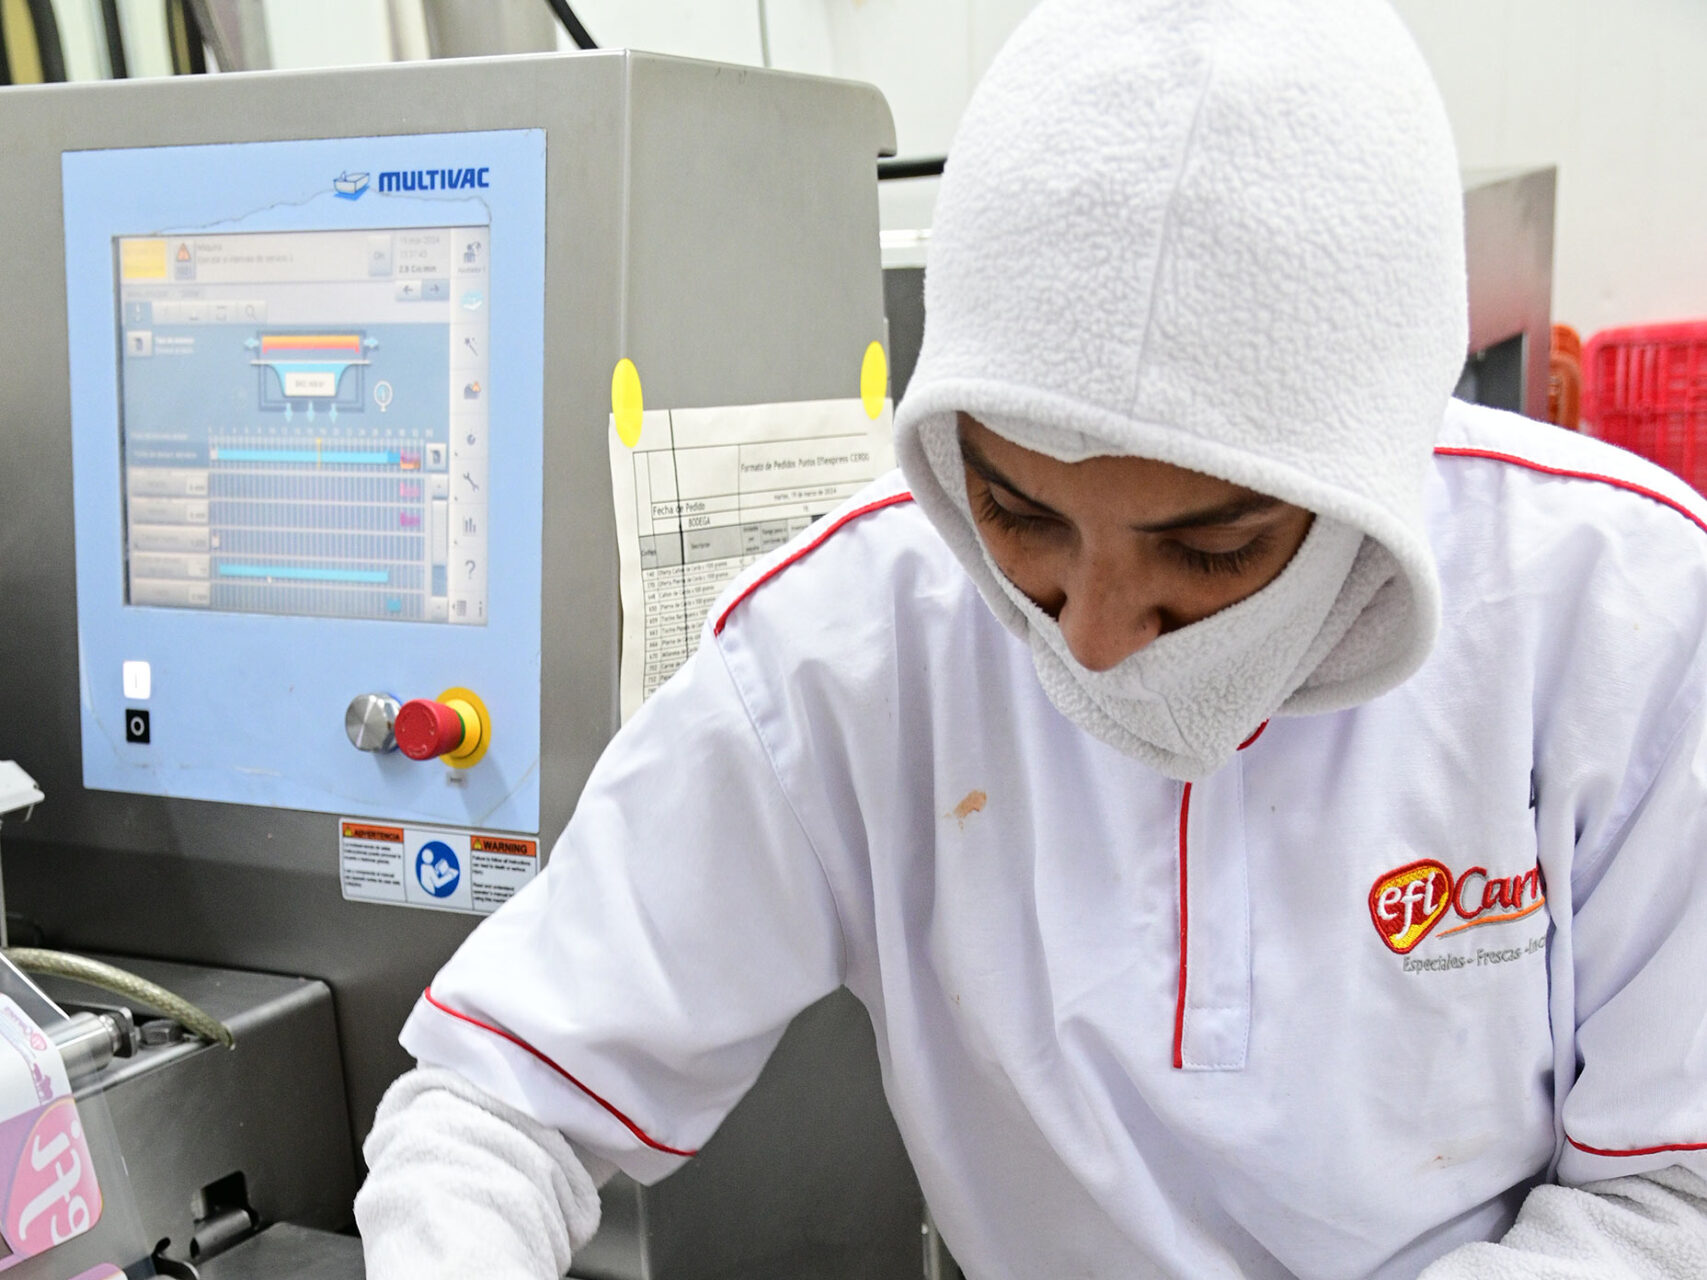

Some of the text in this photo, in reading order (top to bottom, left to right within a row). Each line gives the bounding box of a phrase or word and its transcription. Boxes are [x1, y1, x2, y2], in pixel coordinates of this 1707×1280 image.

[379, 168, 489, 192] MULTIVAC
[653, 505, 674, 516] Fecha
[686, 502, 705, 512] Pedido
[689, 516, 711, 528] BODEGA
[483, 840, 528, 855] WARNING
[1377, 871, 1438, 941] efi
[1403, 954, 1465, 974] Especiales
[1476, 947, 1521, 967] Frescas
